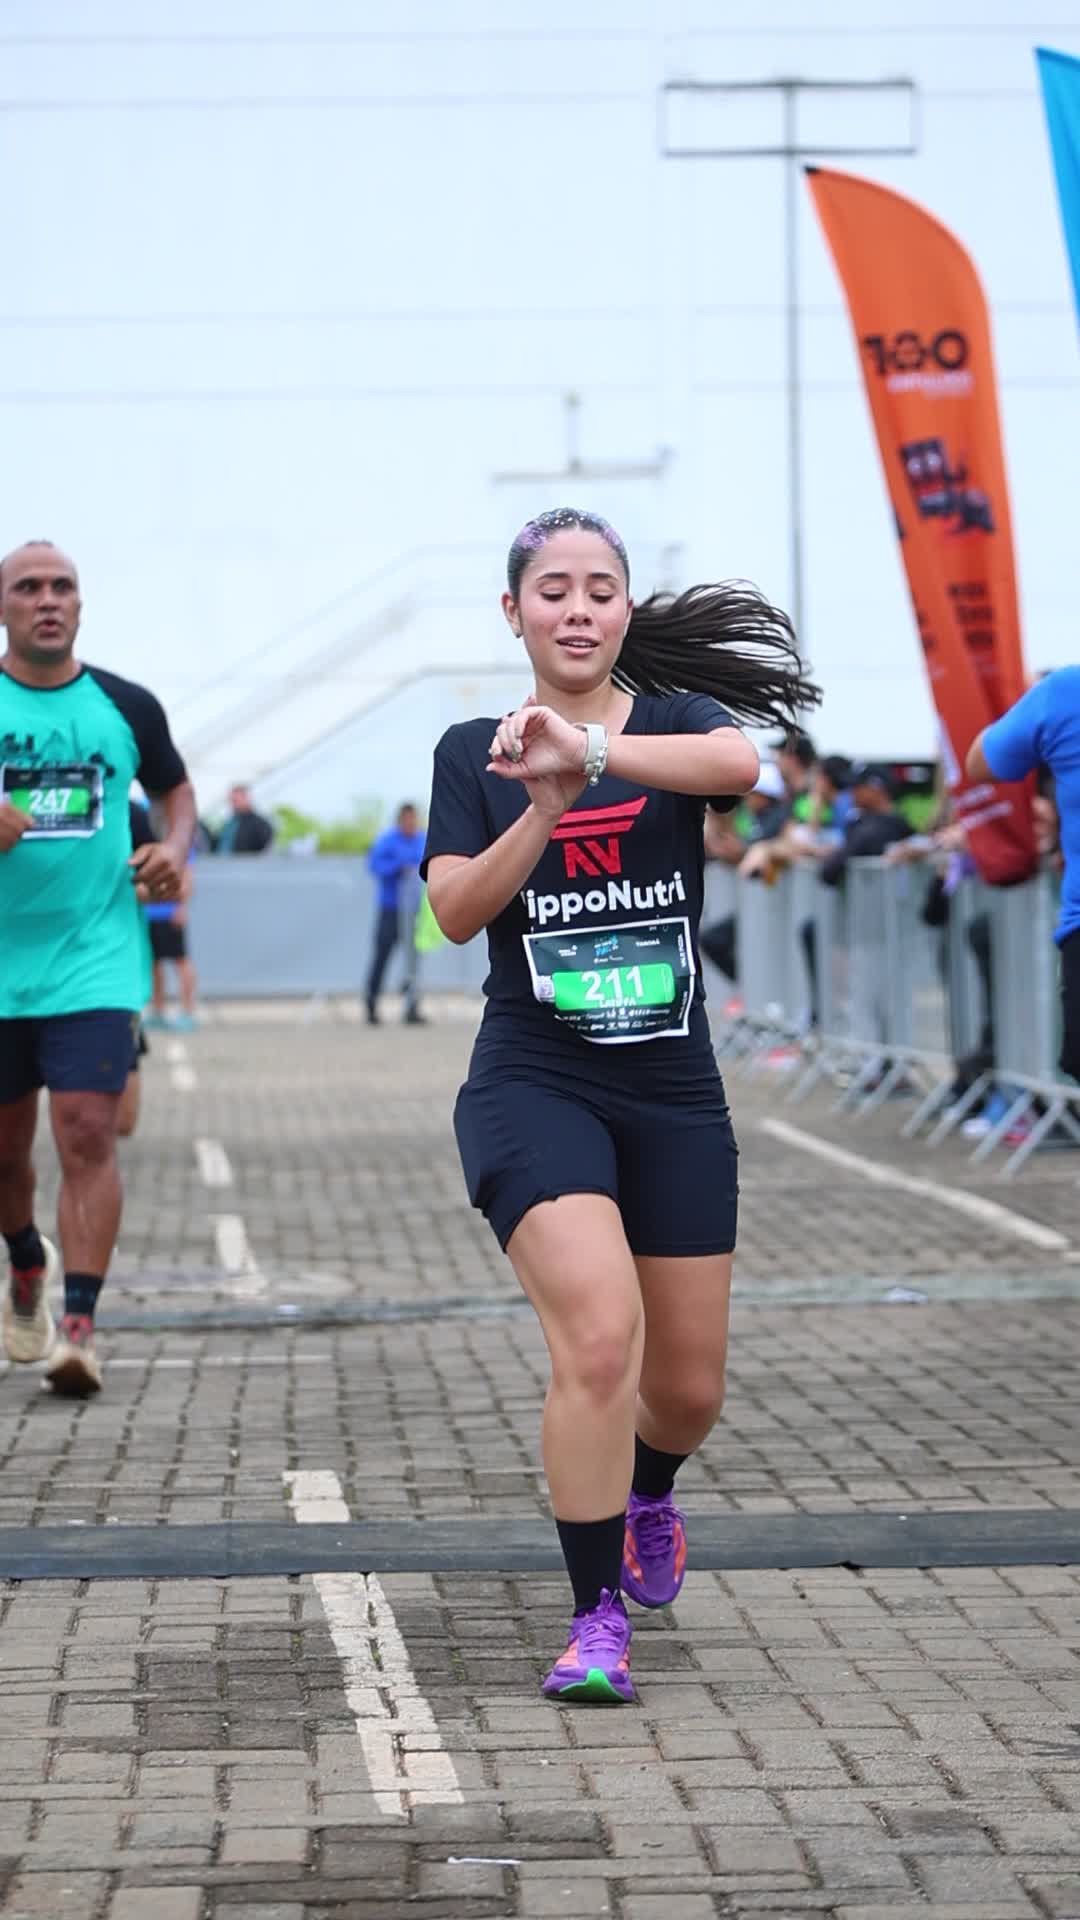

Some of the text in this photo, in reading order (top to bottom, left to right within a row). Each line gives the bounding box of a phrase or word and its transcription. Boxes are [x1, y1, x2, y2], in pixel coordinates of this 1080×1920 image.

[29, 787, 73, 811] 247
[520, 870, 686, 925] ippoNutri
[581, 965, 645, 1001] 211
